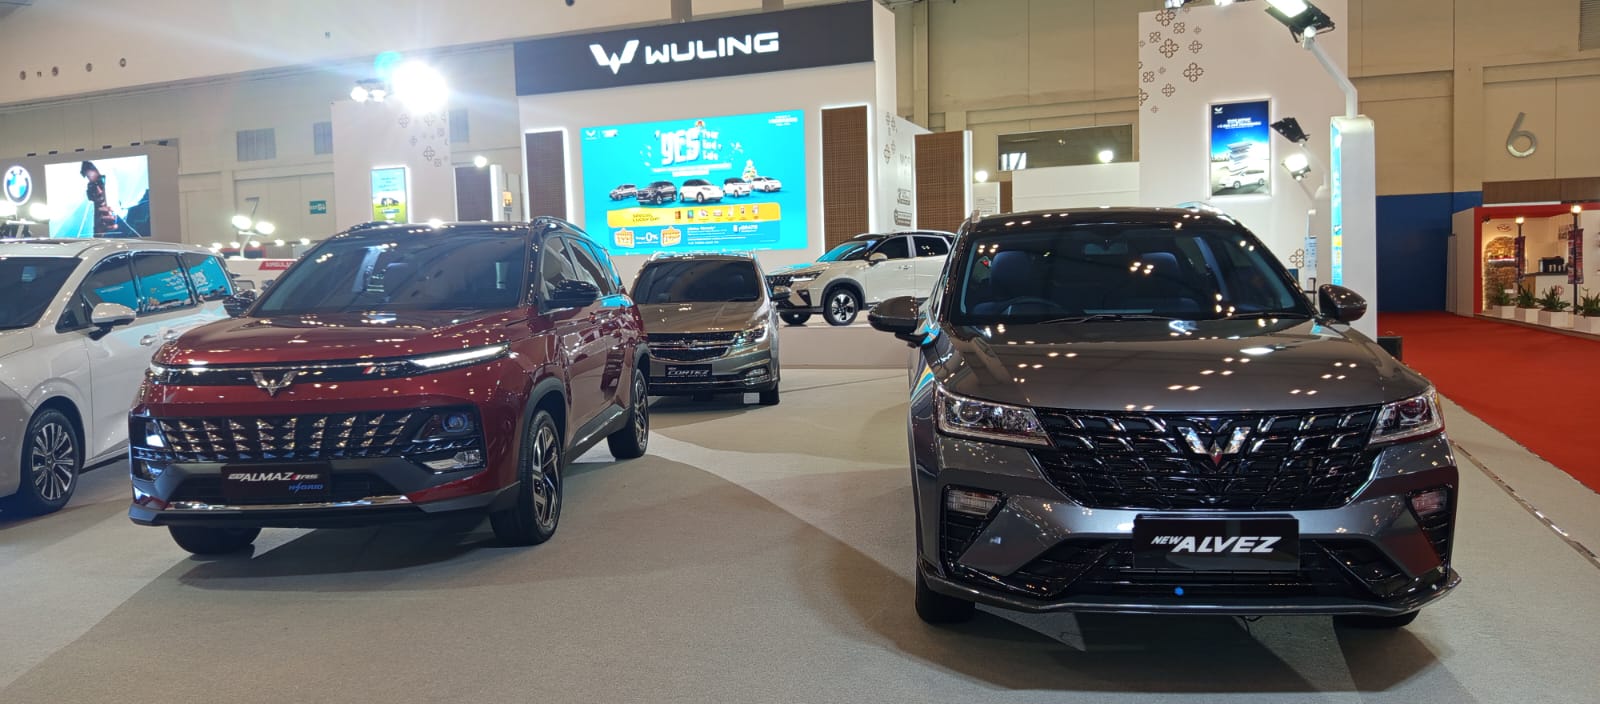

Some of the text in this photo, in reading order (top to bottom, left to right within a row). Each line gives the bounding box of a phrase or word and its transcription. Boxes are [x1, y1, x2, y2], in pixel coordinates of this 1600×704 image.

[645, 32, 779, 64] WULING
[1505, 112, 1537, 158] 6
[240, 472, 294, 482] ALMAZ
[1151, 535, 1282, 553] NEW ALVEZ
